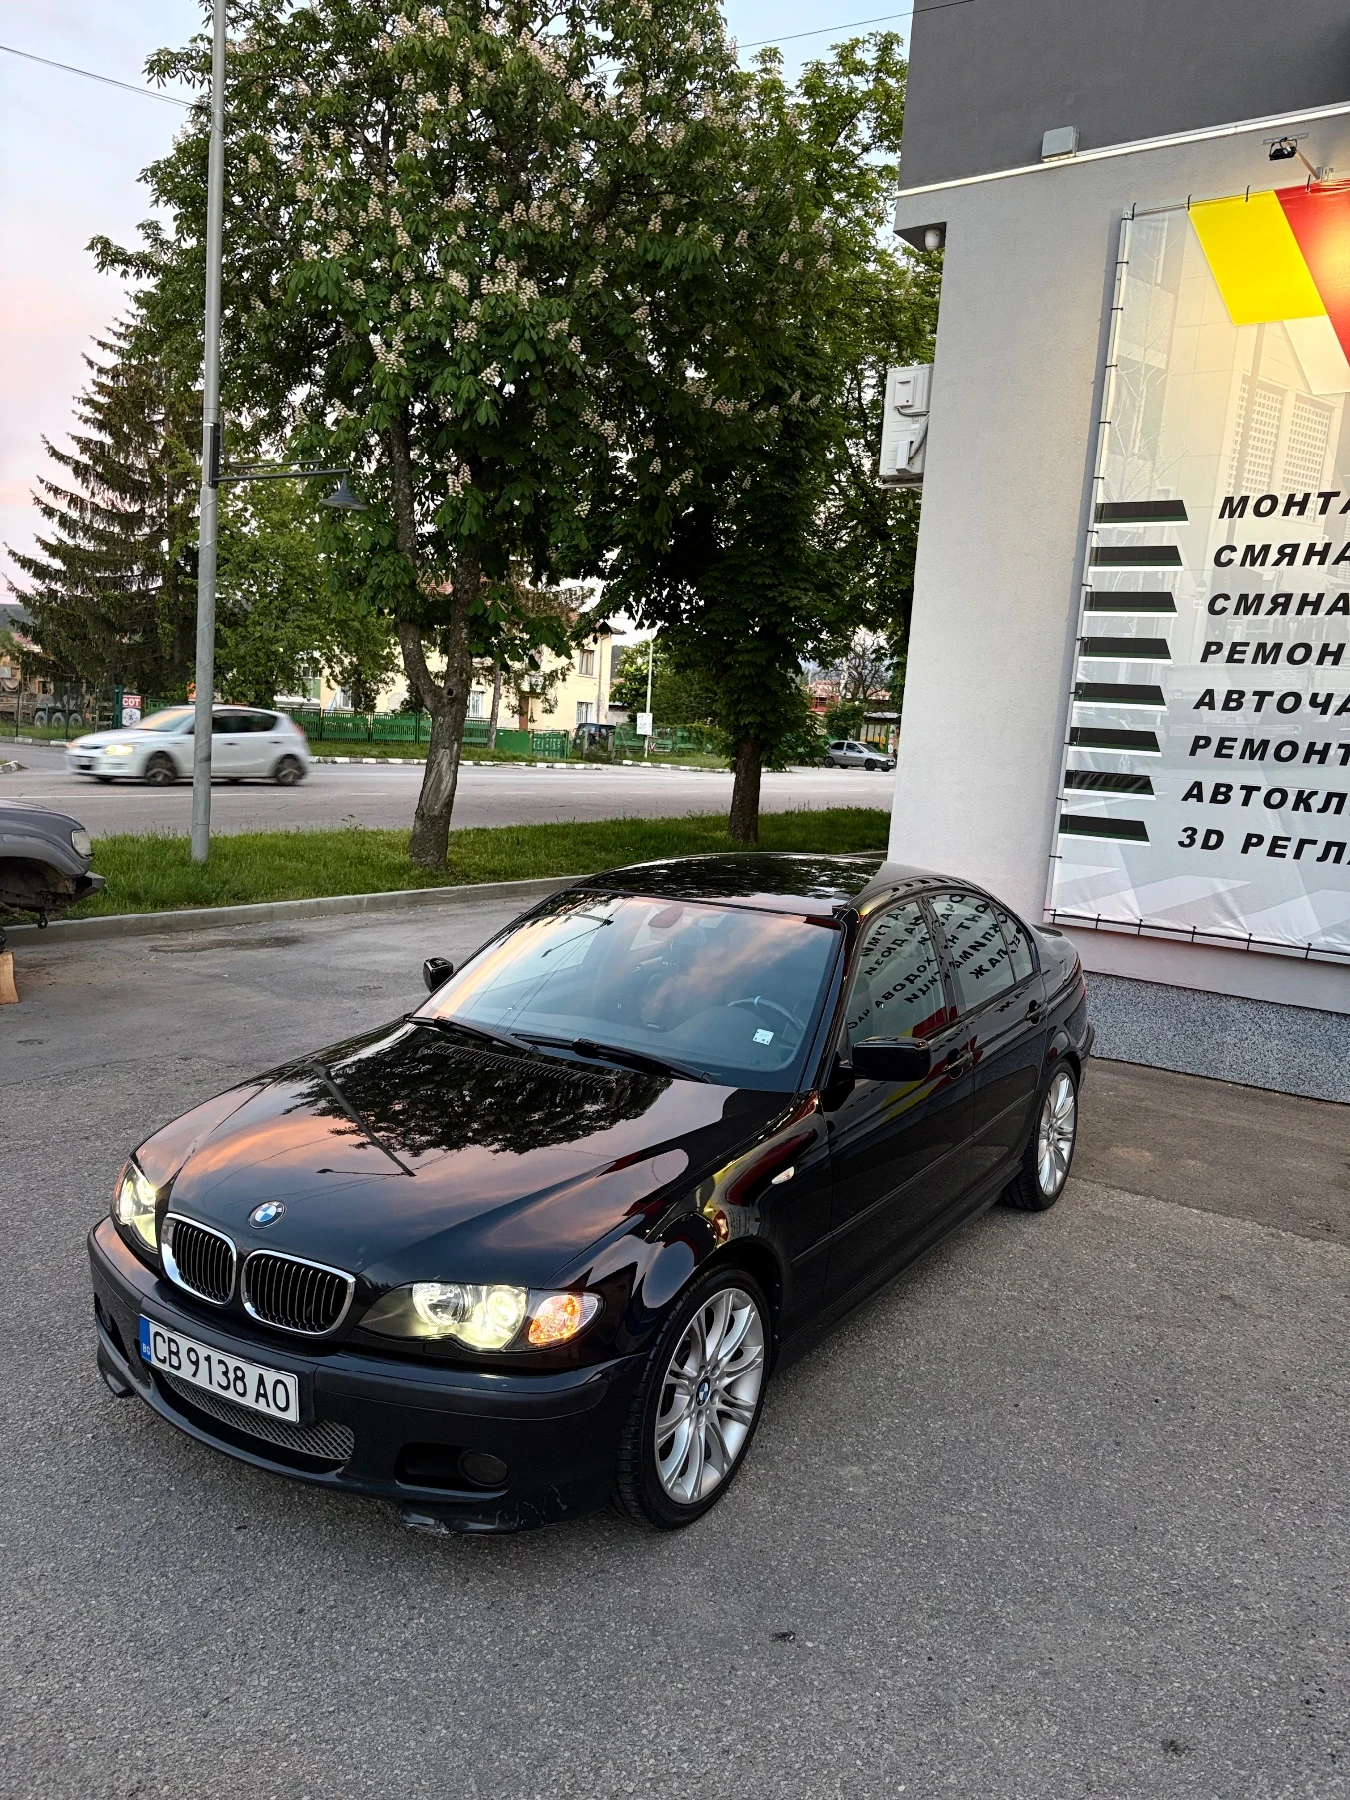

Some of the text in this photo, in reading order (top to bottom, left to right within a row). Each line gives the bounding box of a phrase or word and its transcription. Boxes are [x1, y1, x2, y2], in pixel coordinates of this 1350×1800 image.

[1213, 542, 1350, 567] СМЯНА
[1207, 593, 1350, 616] СМЯНА
[1200, 641, 1346, 666] РЕМОН
[1192, 688, 1350, 716] АВТОЧА
[1188, 735, 1350, 766] РЕМОНТ
[1181, 781, 1348, 815] АВТОКЛ
[1177, 826, 1350, 866] 3D РЕГЛ
[153, 1330, 182, 1371] CB
[186, 1346, 248, 1398] 9138
